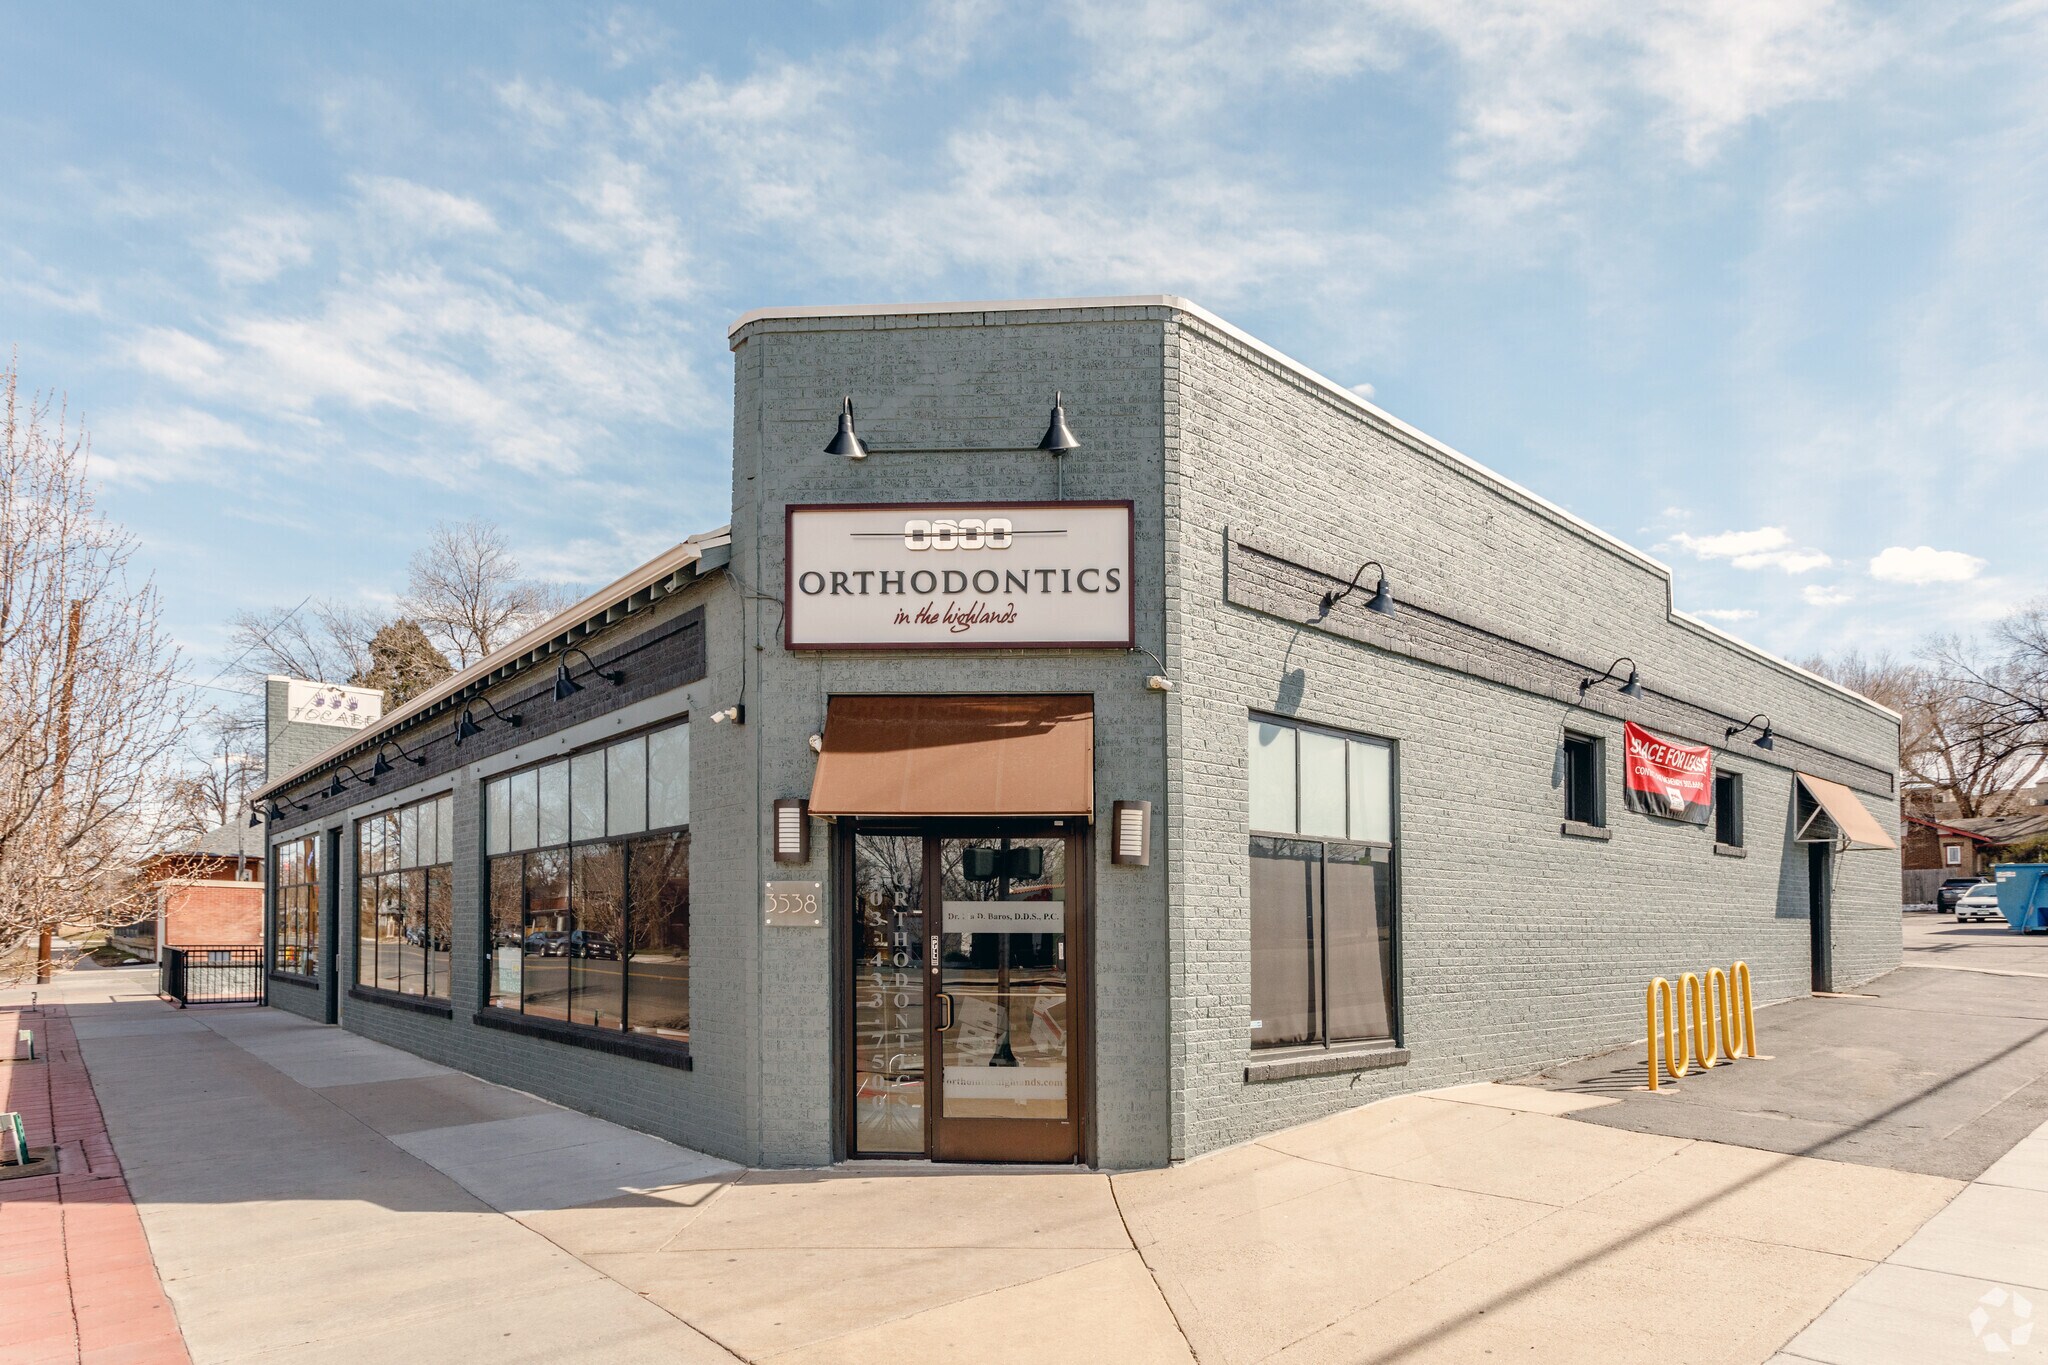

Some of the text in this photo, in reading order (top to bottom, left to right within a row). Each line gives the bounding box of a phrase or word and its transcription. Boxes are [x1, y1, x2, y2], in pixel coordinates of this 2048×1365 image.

[799, 568, 1121, 595] ORTHODONTICS
[893, 600, 1018, 633] in the highlands
[290, 706, 377, 727] TOCABE
[1665, 748, 1686, 769] FOR
[766, 893, 817, 914] 3538
[988, 912, 1013, 921] Baros,
[869, 872, 885, 1113] 03.433.7500
[893, 870, 909, 1112] ORTHODONTICS
